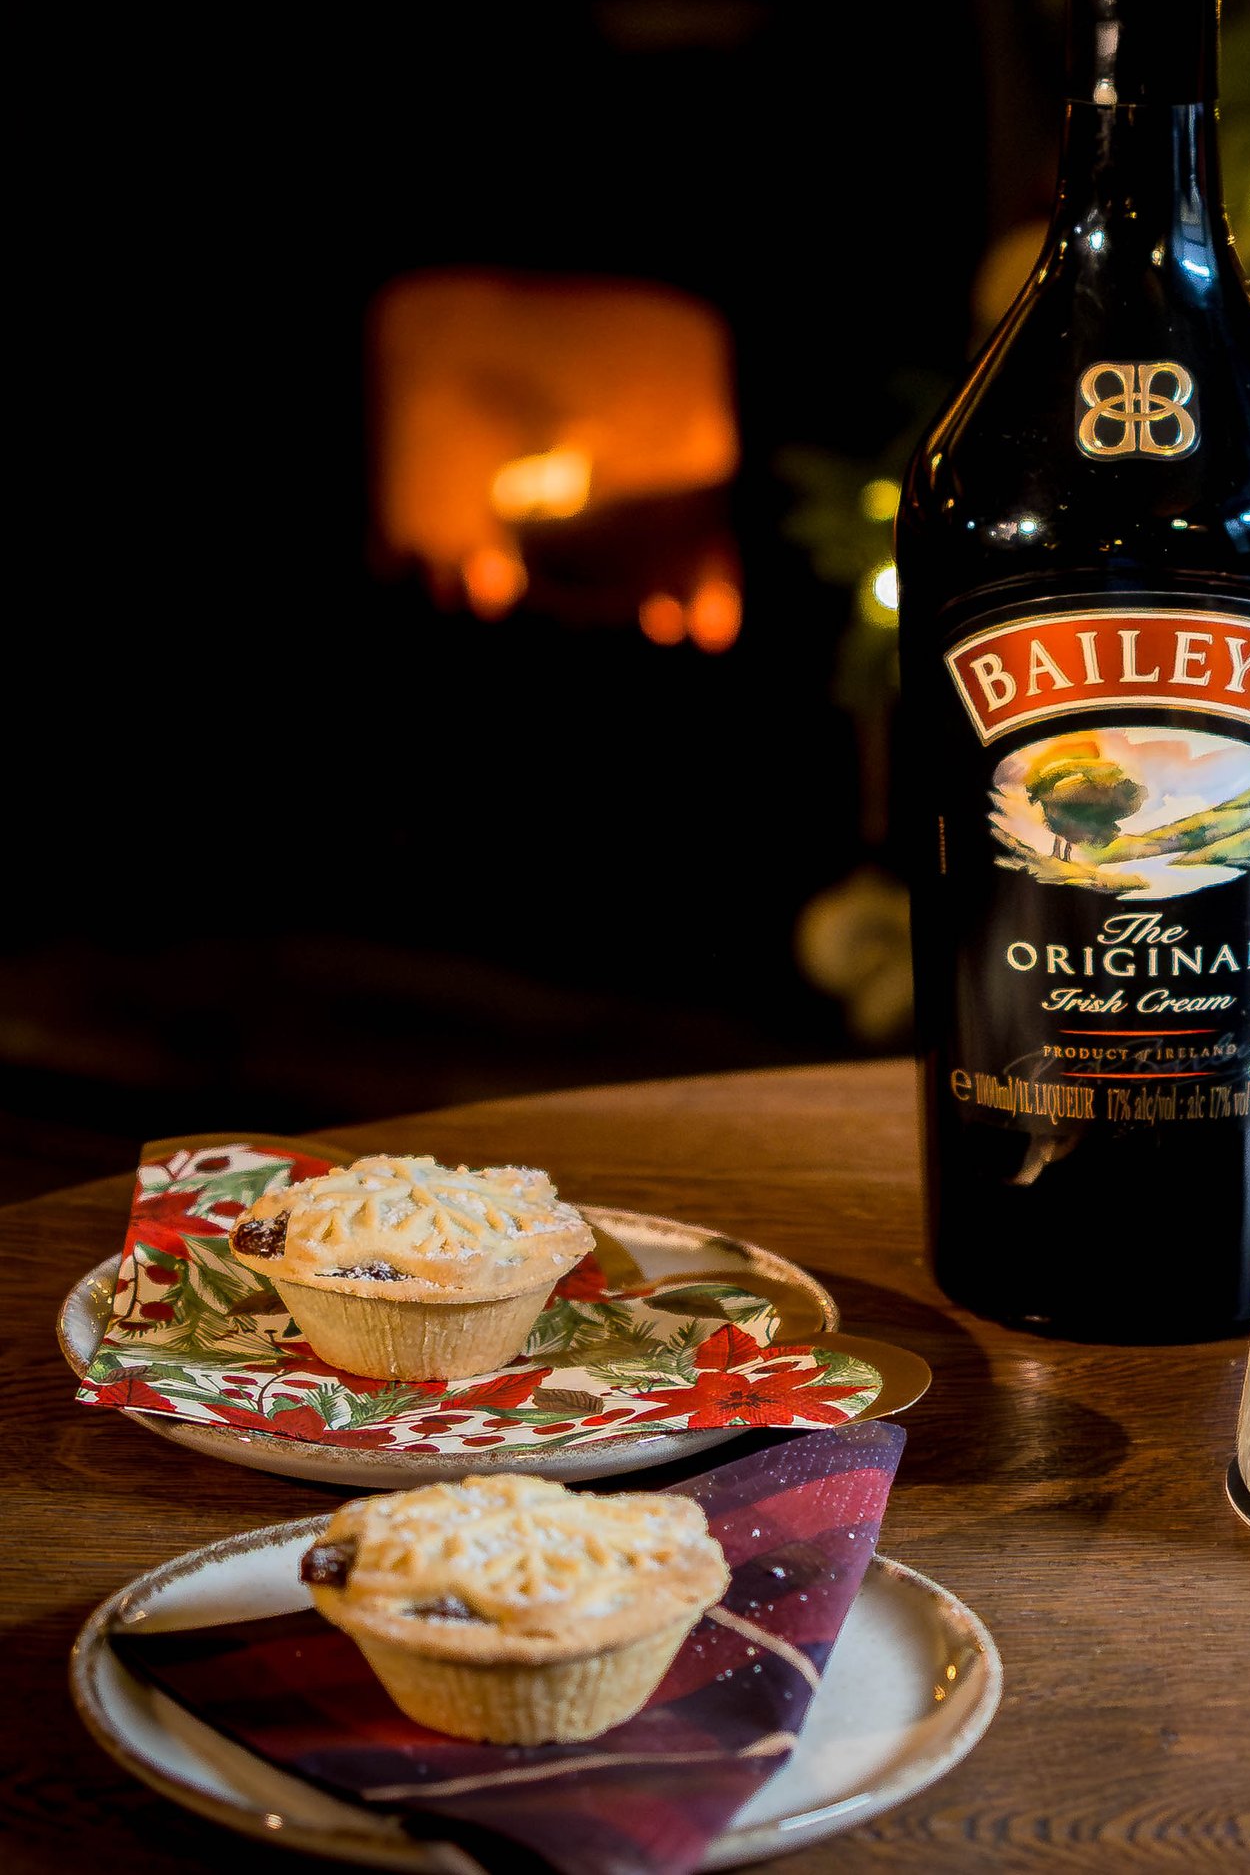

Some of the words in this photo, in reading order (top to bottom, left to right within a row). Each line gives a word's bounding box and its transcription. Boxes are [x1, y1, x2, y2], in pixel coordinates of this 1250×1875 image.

[1097, 912, 1188, 945] The
[1041, 988, 1128, 1013] Irish
[1136, 988, 1238, 1013] Cream
[1042, 1044, 1129, 1061] PRODUCT
[1156, 1043, 1238, 1060] IRELAND
